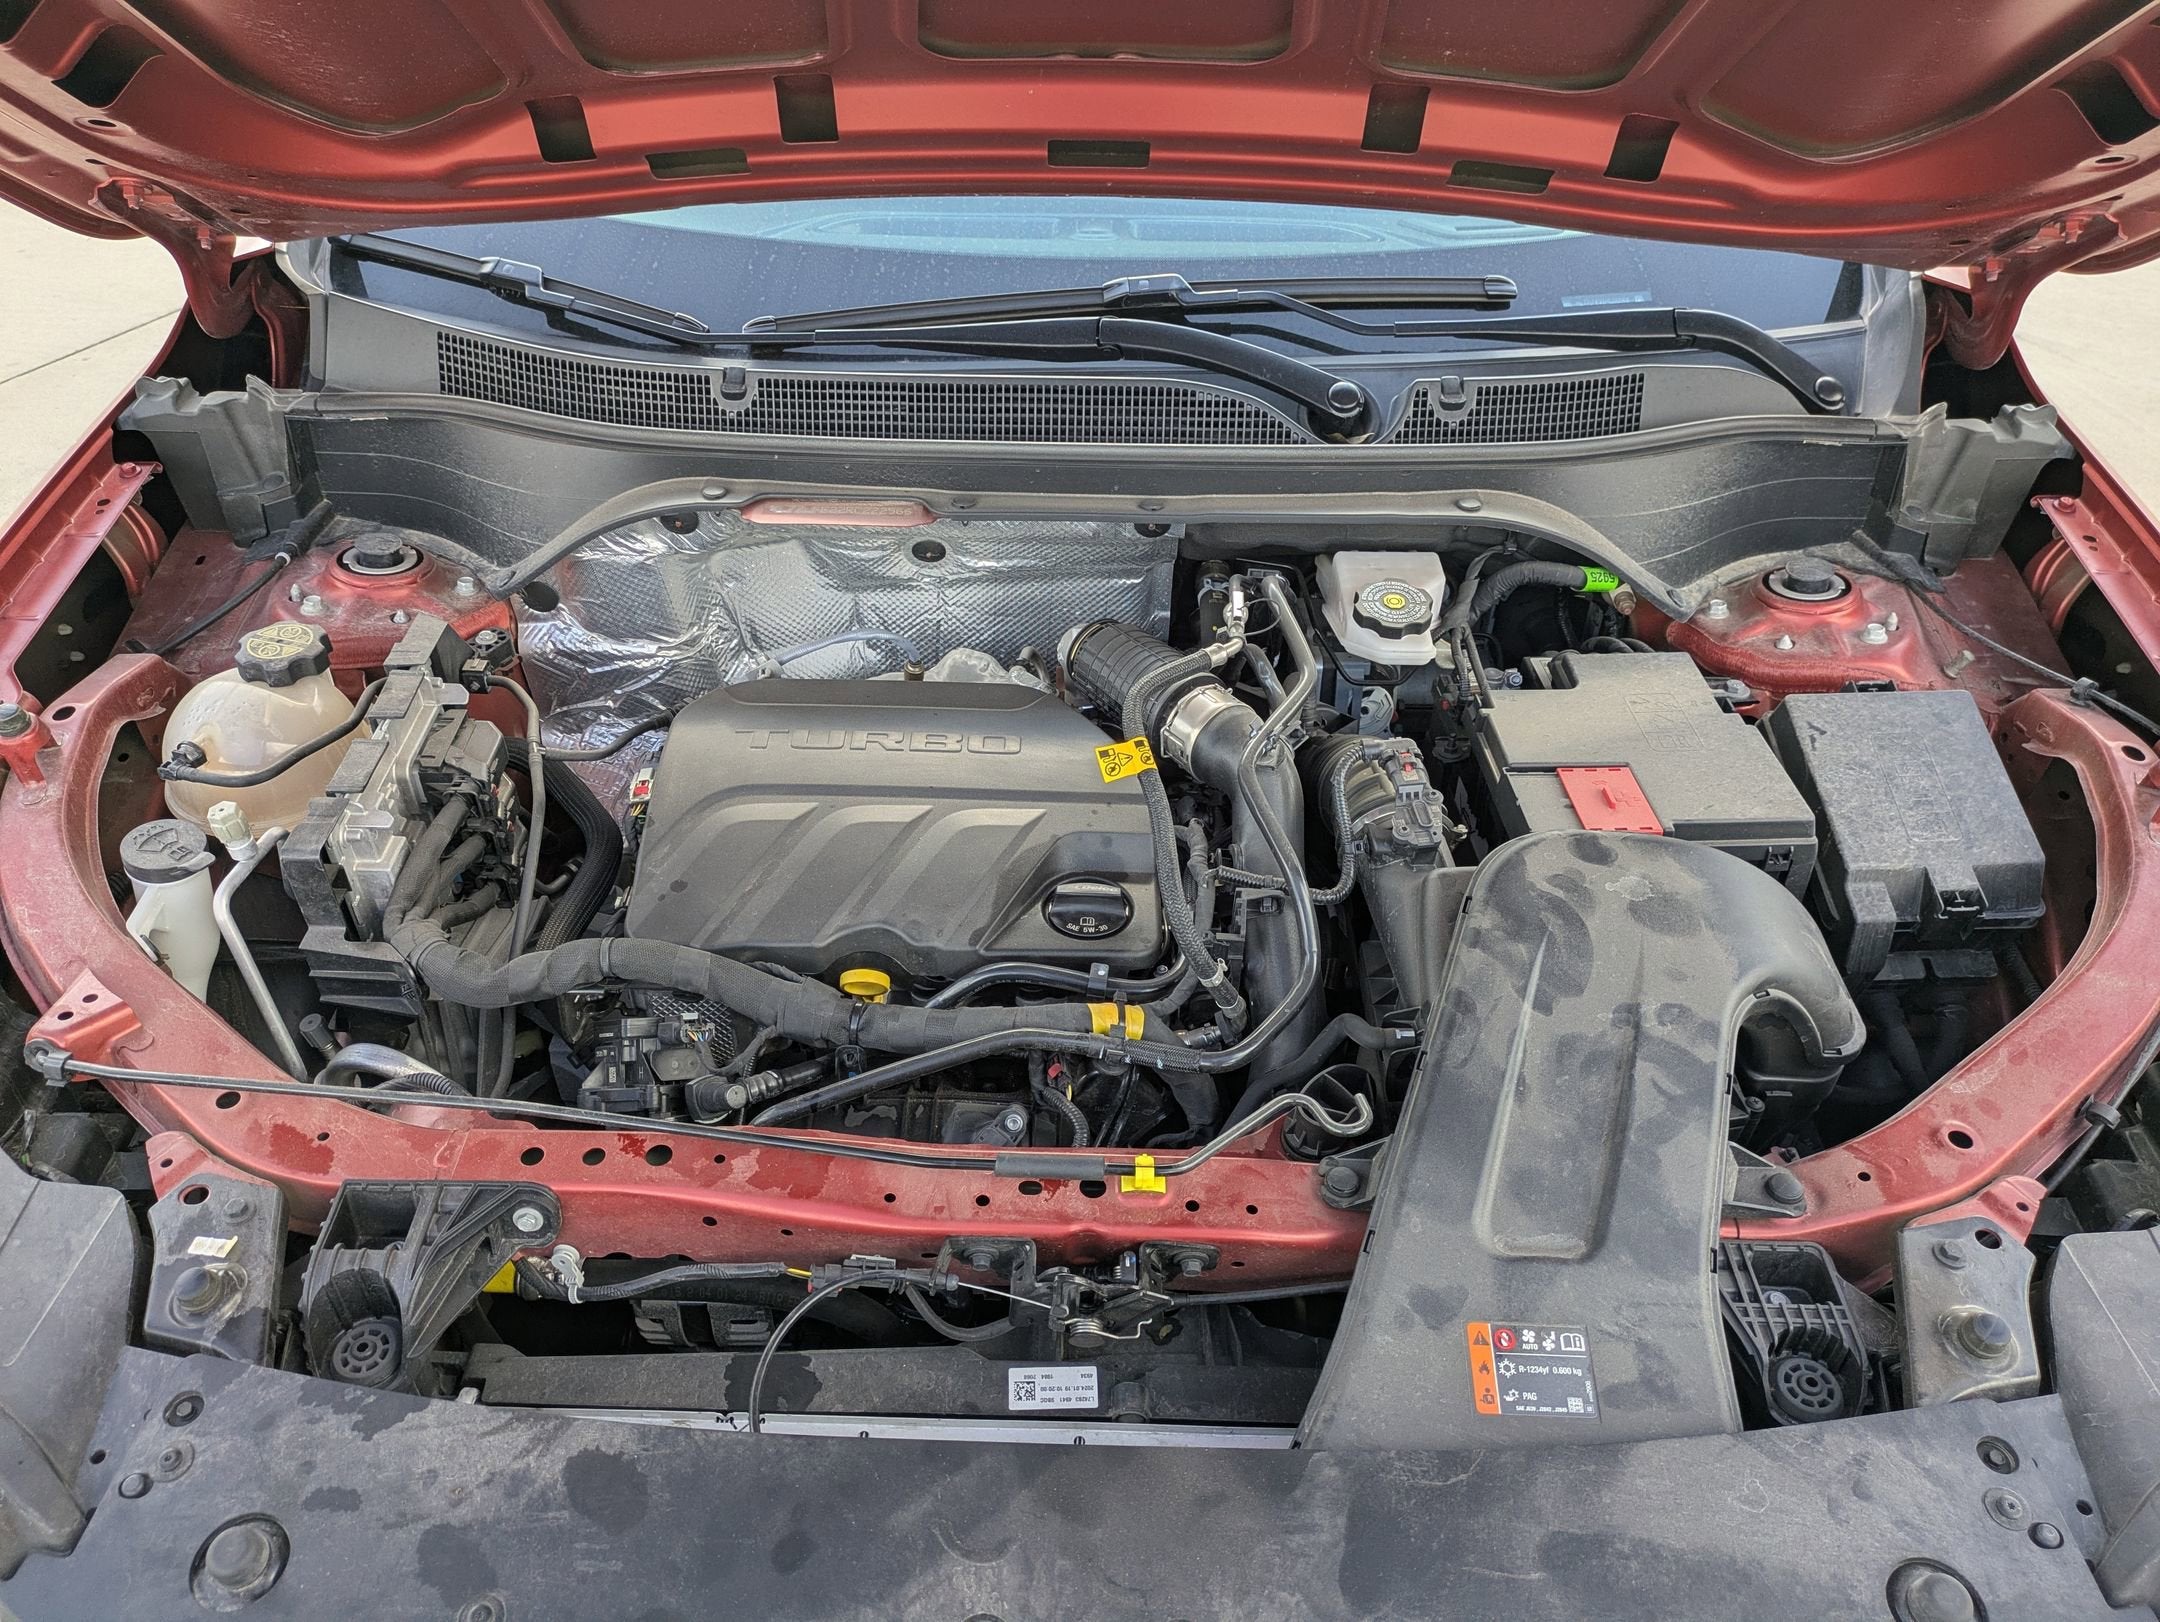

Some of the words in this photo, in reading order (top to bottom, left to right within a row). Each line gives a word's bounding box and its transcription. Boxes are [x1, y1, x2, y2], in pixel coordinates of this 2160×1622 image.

[1590, 572, 1615, 583] 5925
[734, 728, 1022, 755] TURBO
[1066, 922, 1080, 932] SAE
[1083, 924, 1108, 933] 5W-30
[1518, 1365, 1549, 1374] R-1234yf
[1552, 1366, 1572, 1375] 0.600
[1573, 1366, 1582, 1377] kg
[1522, 1392, 1537, 1401] PAG
